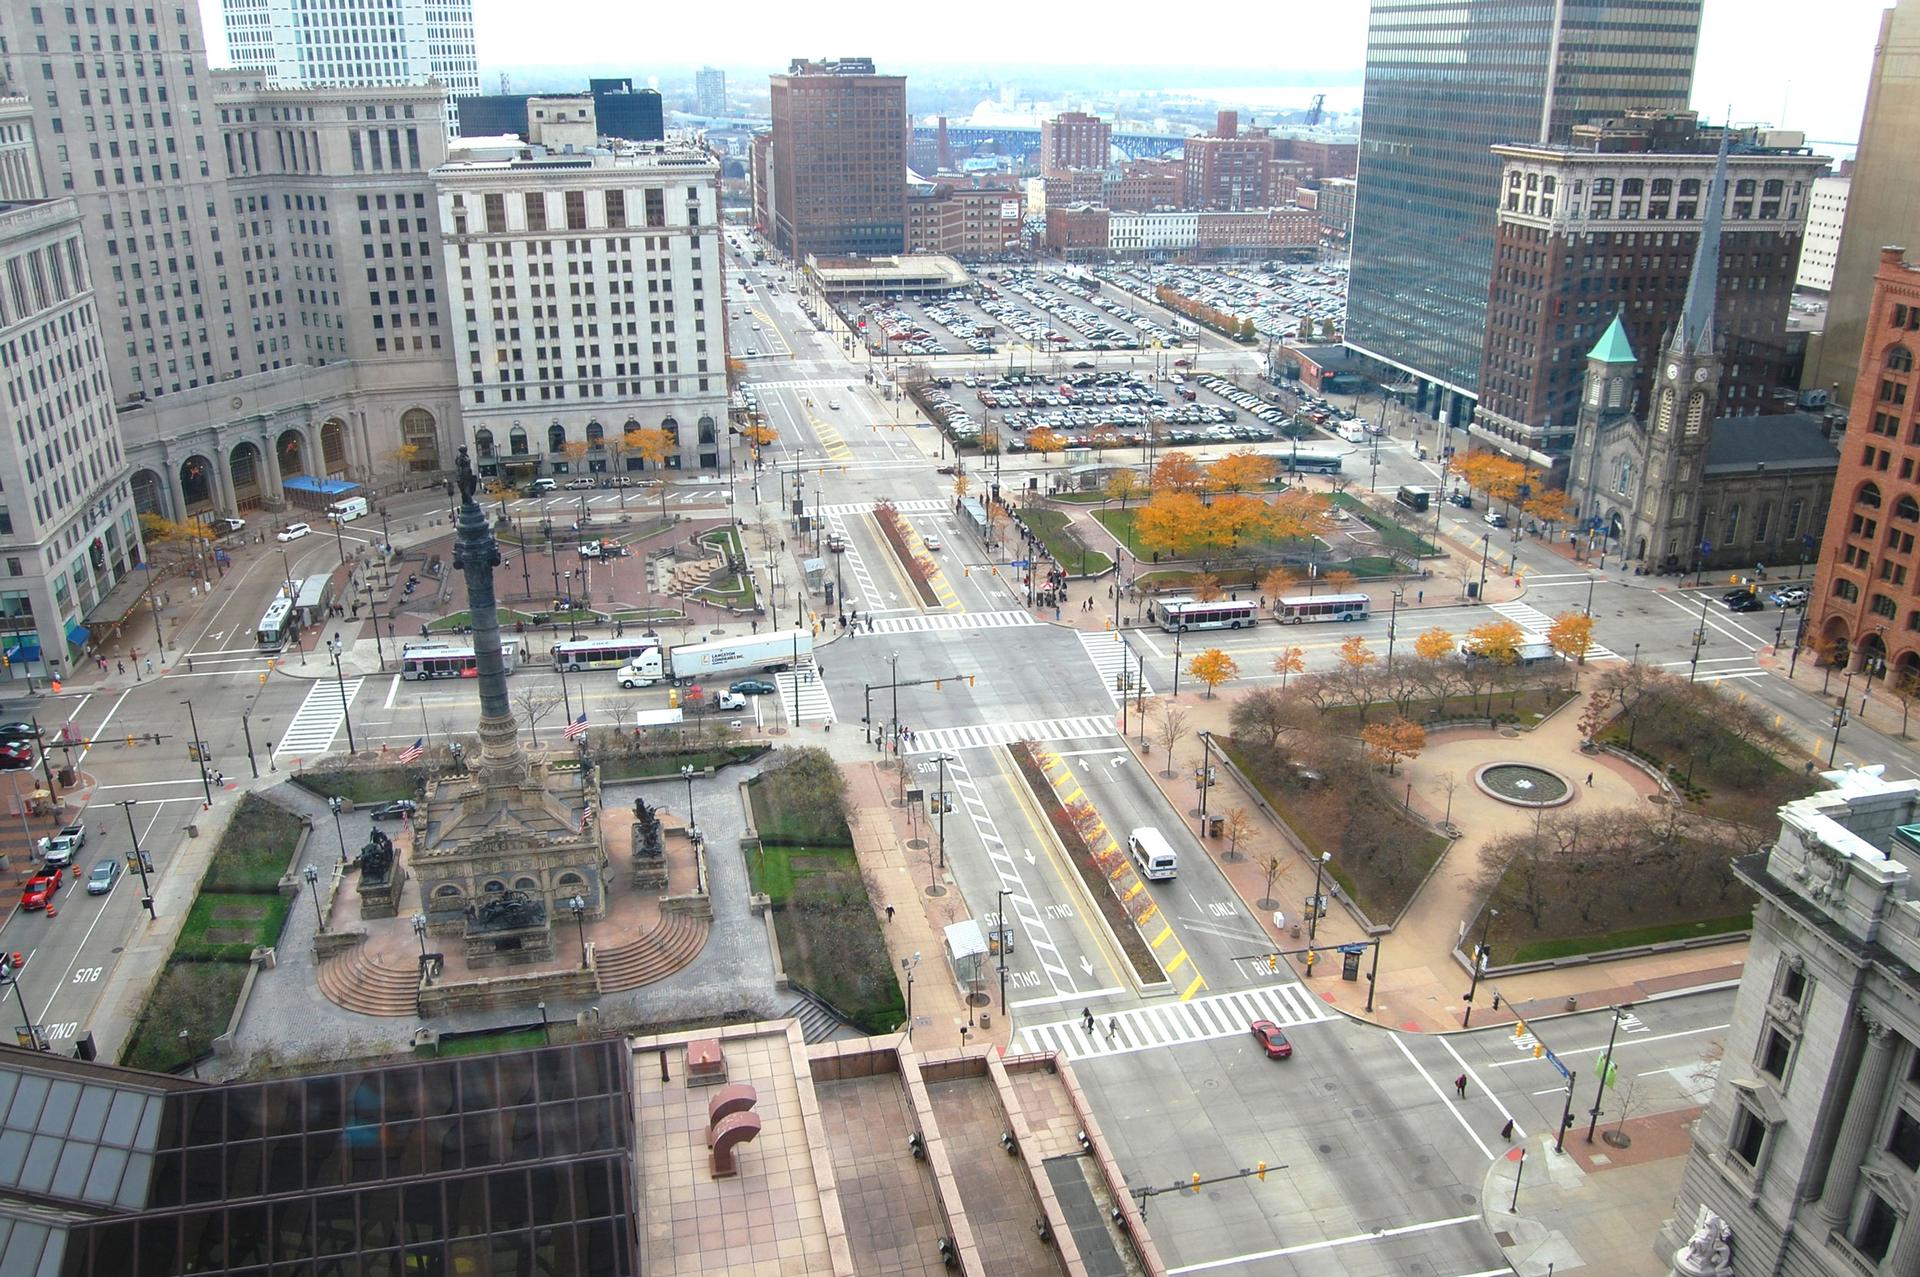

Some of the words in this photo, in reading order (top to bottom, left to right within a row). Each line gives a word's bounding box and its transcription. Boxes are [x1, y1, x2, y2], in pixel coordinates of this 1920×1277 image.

[917, 762, 938, 774] BUS
[1044, 903, 1073, 920] ONLY
[1208, 901, 1239, 917] ONLY
[983, 911, 1009, 927] BUS
[72, 966, 103, 984] BUS
[1010, 971, 1041, 989] ONLY
[1611, 1013, 1652, 1034] ONLY
